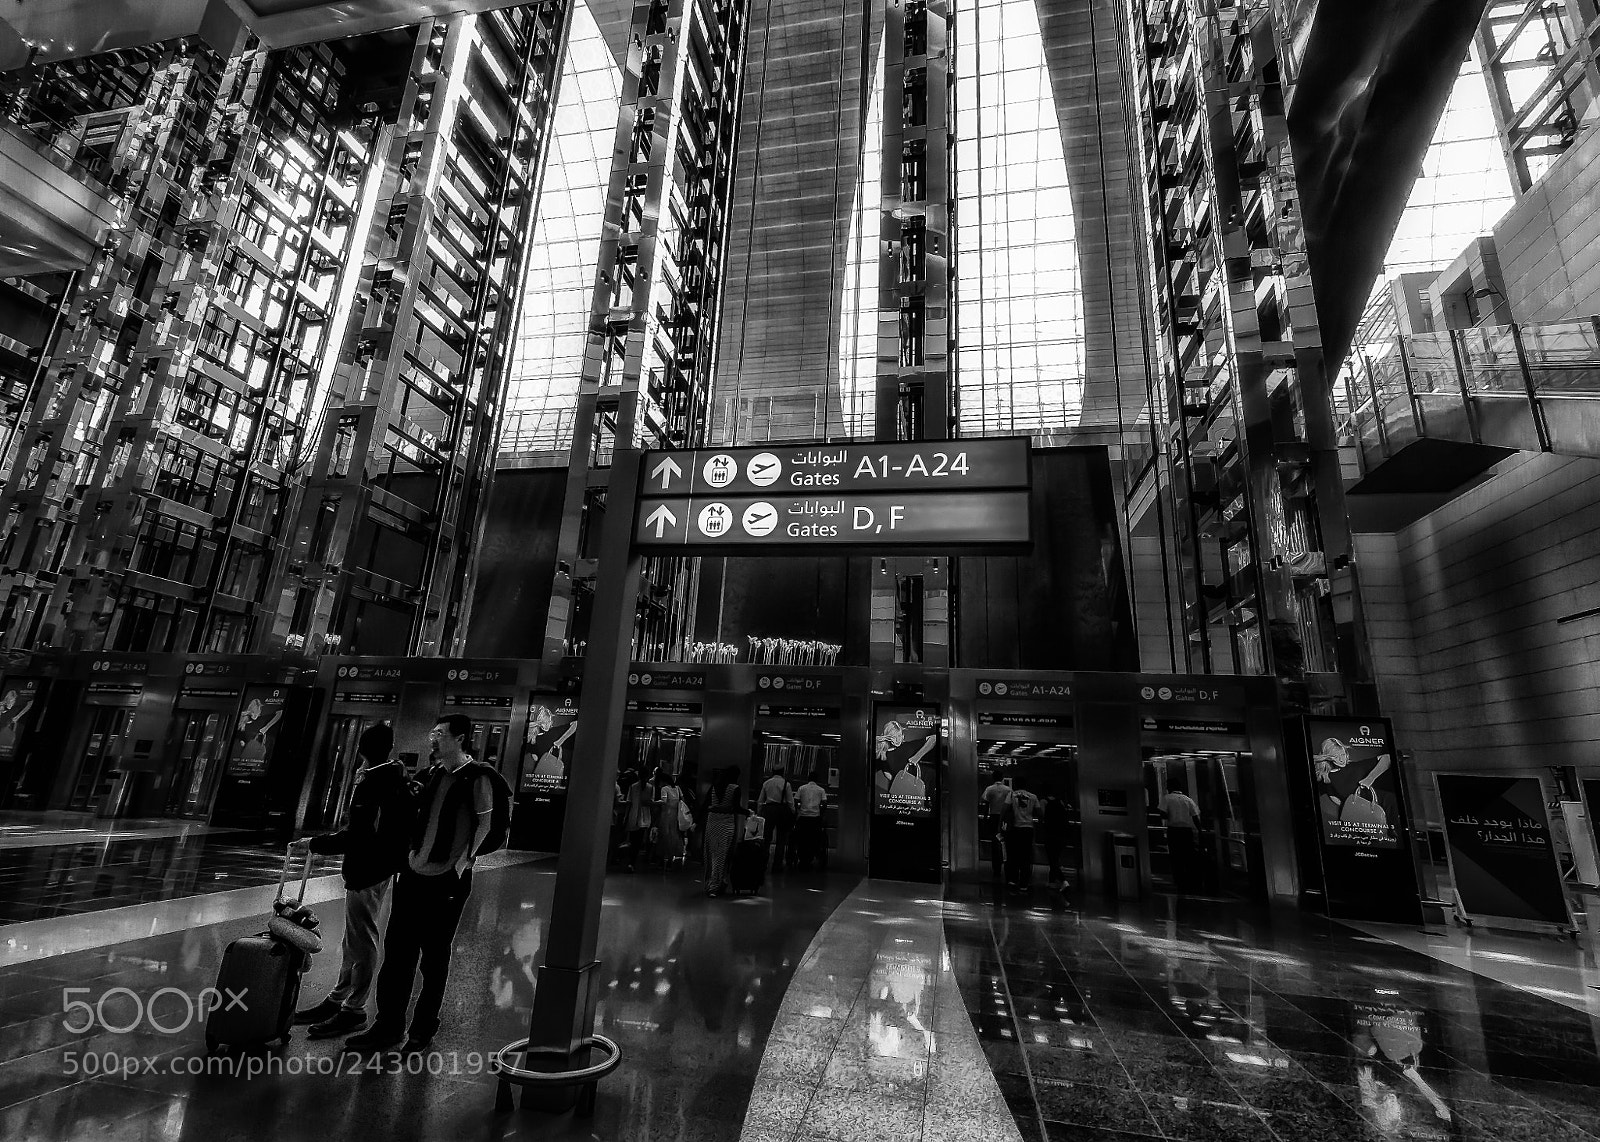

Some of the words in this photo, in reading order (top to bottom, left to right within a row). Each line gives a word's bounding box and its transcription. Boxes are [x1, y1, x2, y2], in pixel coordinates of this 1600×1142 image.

[791, 449, 848, 467] البوابات
[853, 452, 970, 479] A1-A24
[790, 471, 840, 486] Gates
[787, 500, 845, 517] البوابات
[786, 522, 838, 537] Gates
[671, 676, 703, 685] A1-A24
[1032, 686, 1071, 696] A1-A24
[1349, 737, 1385, 745] AIGNER
[1450, 814, 1479, 825] خلف
[1483, 819, 1514, 830] يوجد
[1518, 818, 1543, 829] ماذا
[1521, 833, 1546, 844] هذا
